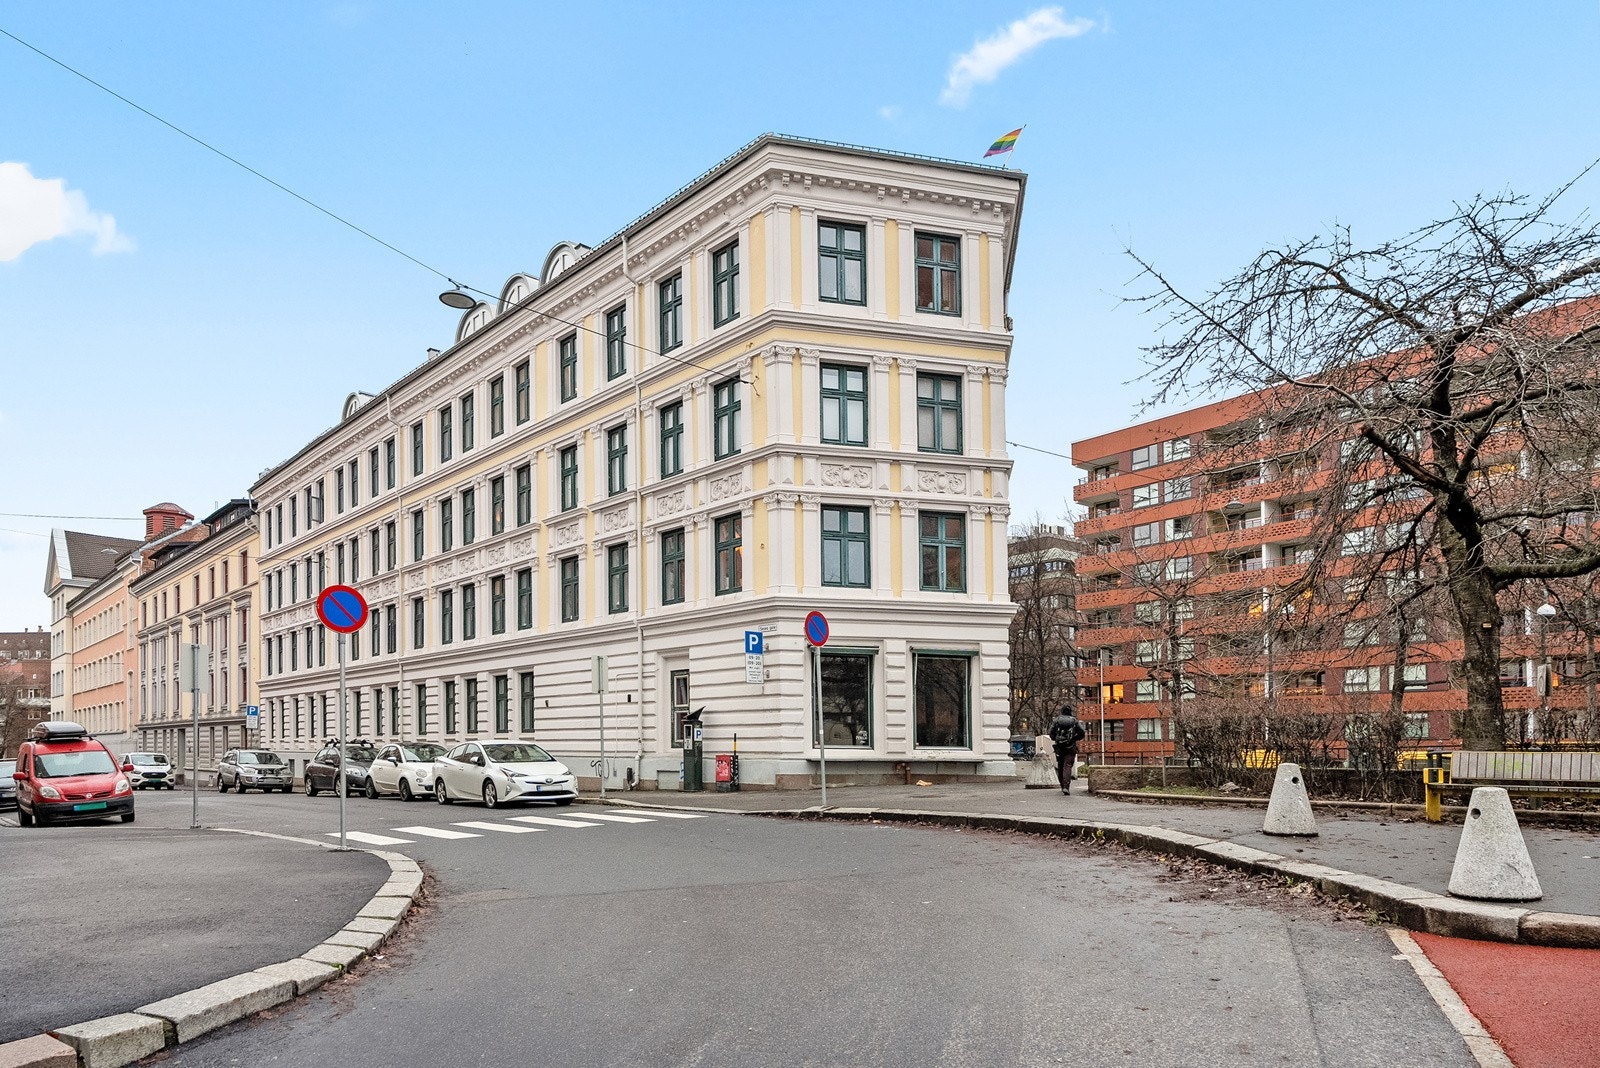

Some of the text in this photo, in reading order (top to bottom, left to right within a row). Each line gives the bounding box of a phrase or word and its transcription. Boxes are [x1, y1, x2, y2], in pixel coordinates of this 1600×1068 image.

[749, 634, 759, 651] P
[249, 706, 256, 715] P
[696, 730, 702, 739] P
